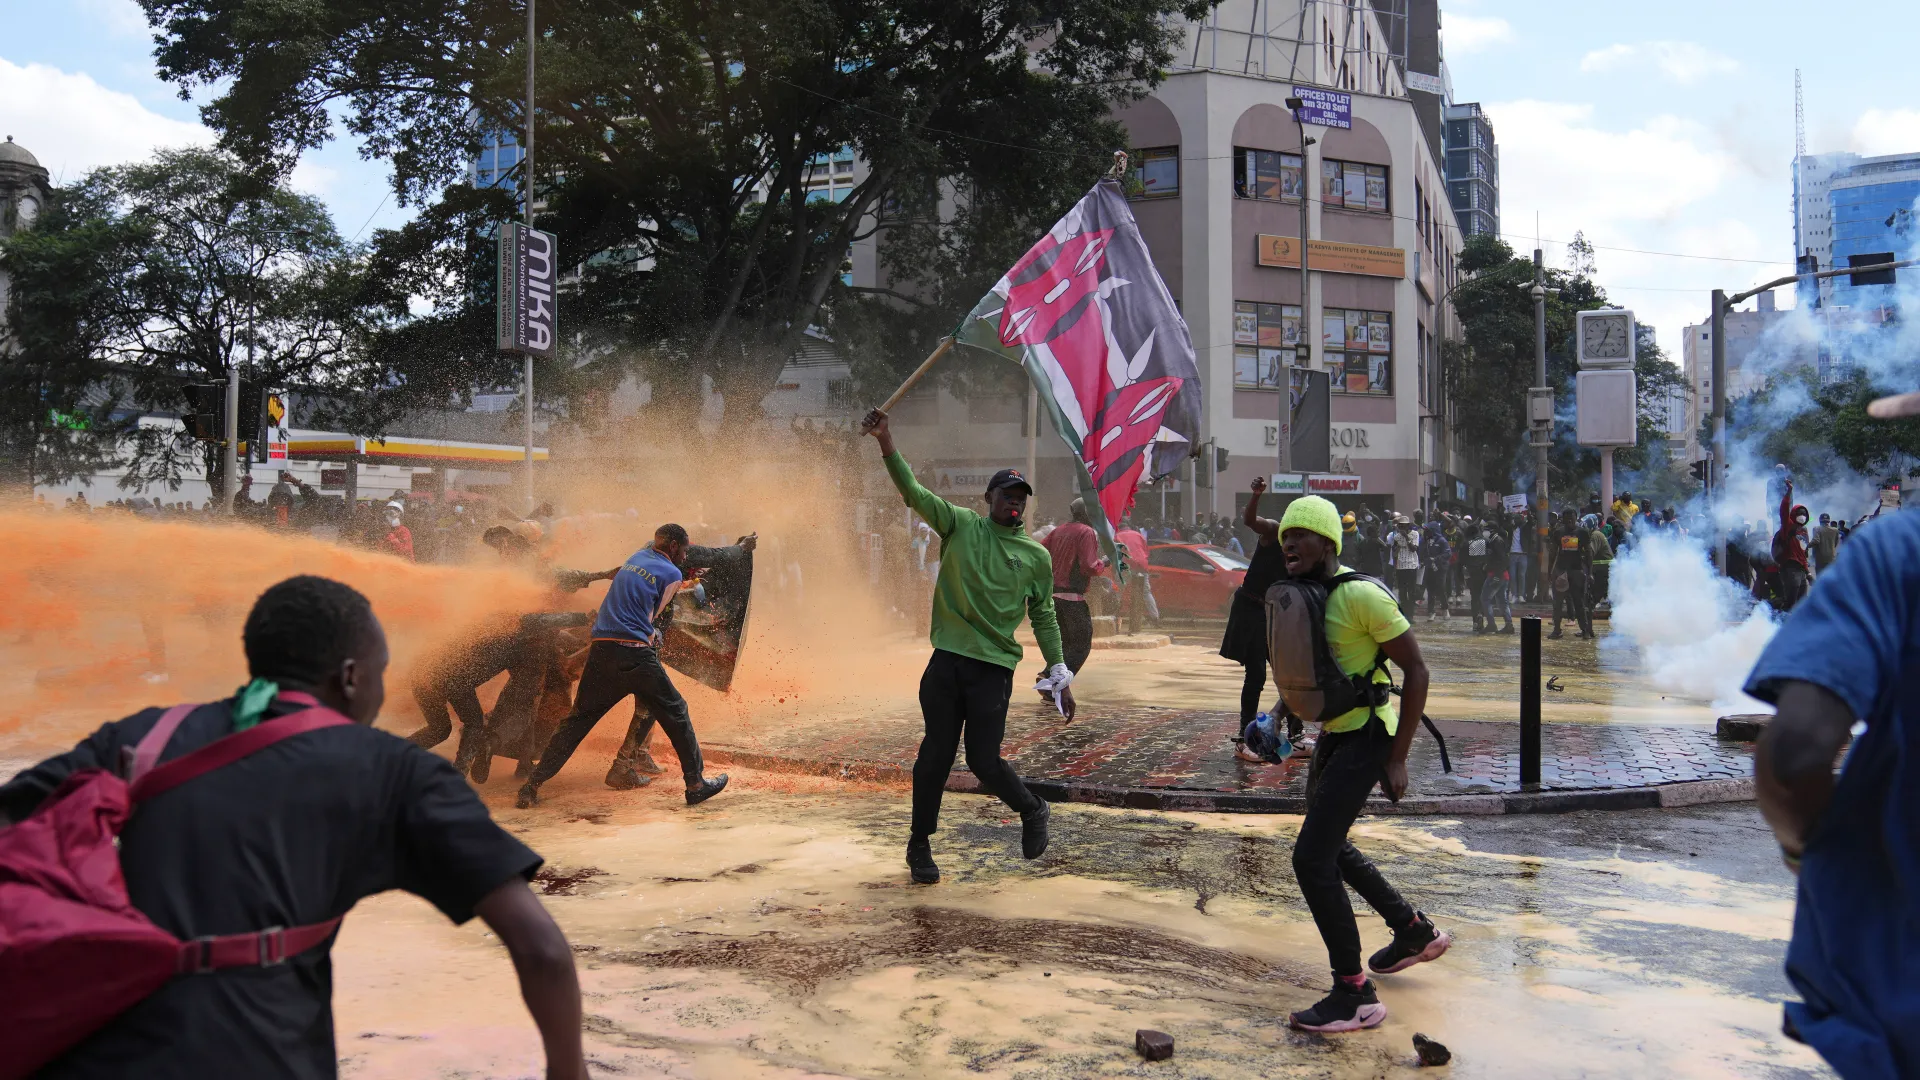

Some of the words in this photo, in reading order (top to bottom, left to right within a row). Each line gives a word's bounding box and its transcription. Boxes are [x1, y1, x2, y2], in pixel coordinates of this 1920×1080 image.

[1294, 88, 1325, 101] OFFICES
[1326, 93, 1336, 102] TO
[1337, 95, 1350, 105] LET
[1316, 100, 1331, 110] 320
[1333, 246, 1359, 254] INSTITUTE
[1368, 250, 1404, 258] MANAGEMENT
[529, 229, 551, 351] MIKA
[1264, 425, 1370, 448] EROR
[1308, 479, 1360, 491] PHARMACY
